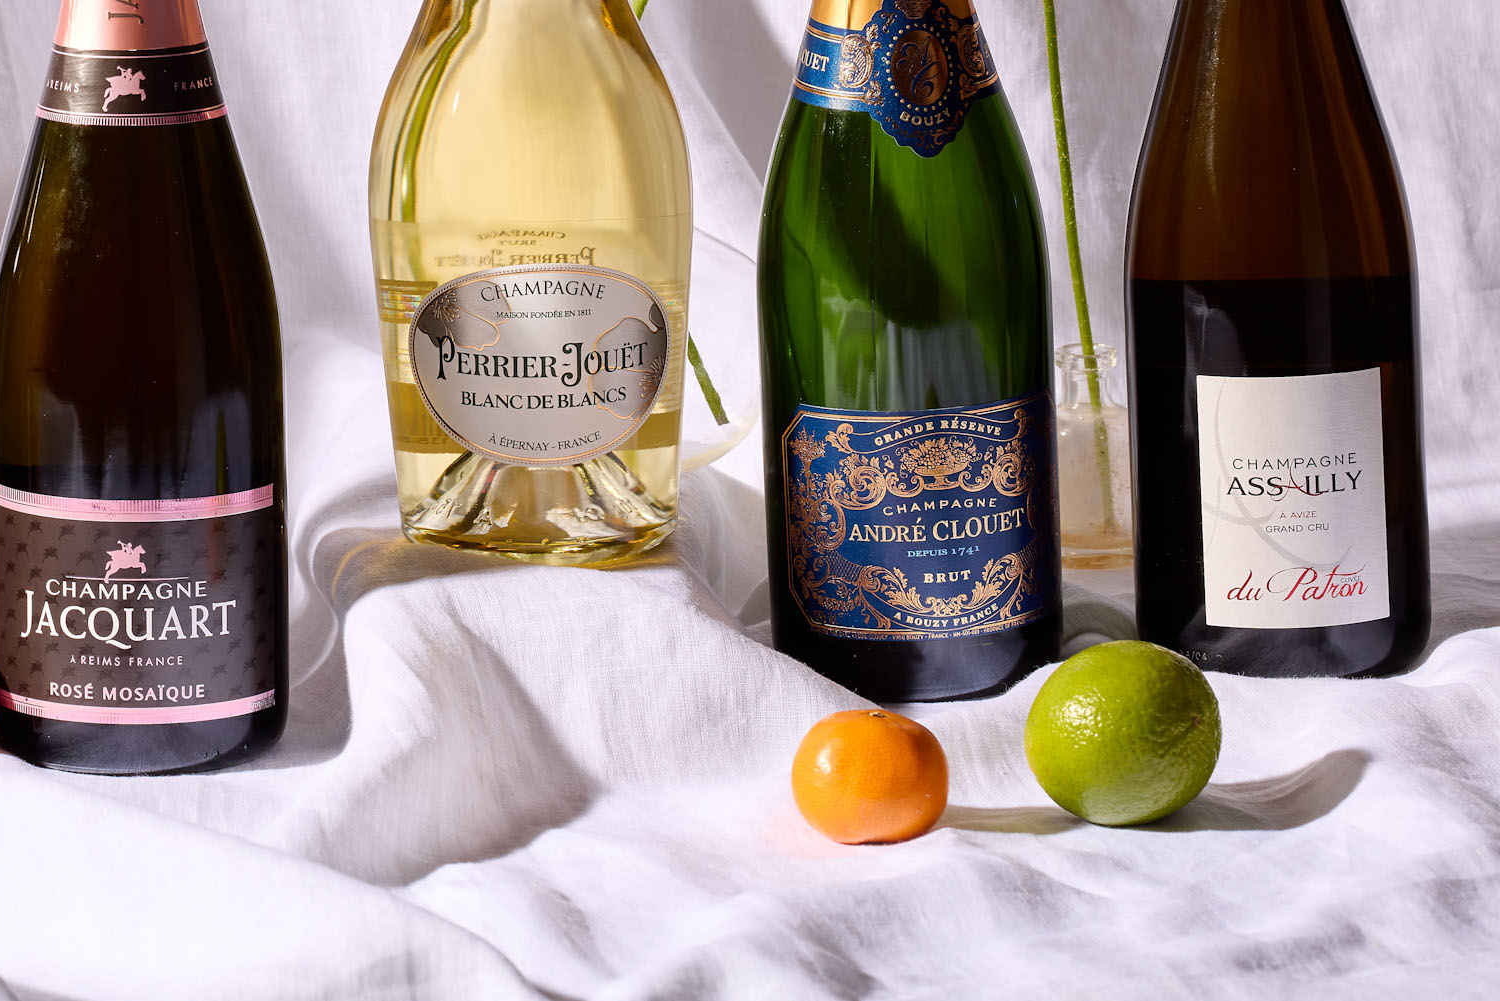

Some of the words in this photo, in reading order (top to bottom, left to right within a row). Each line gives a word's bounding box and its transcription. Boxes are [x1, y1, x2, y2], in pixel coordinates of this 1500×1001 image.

[50, 80, 80, 93] REIMS
[173, 76, 214, 92] FRANCE
[899, 107, 951, 127] BOUZY
[480, 280, 606, 302] CHAMPAGNE
[495, 310, 529, 319] MAISON
[530, 309, 564, 319] FONDÉE
[564, 309, 577, 317] EN
[577, 308, 592, 317] 1811
[436, 335, 649, 387] PERRIER-JOUËT
[461, 390, 523, 410] BLANC
[526, 395, 555, 410] DE
[556, 386, 627, 409] BLANCS
[488, 433, 497, 444] À
[499, 434, 550, 451] ÉPERNAY
[557, 430, 602, 449] FRANCE
[874, 421, 935, 446] GRANDE
[940, 416, 1003, 437] RÉSERVE
[1232, 452, 1357, 470] CHAMPAGNE
[882, 497, 998, 517] CHAMPAGNE
[1290, 510, 1317, 519] AVIZE
[848, 517, 927, 543] ANDRÉ
[932, 507, 1025, 541] CLOUET
[1265, 524, 1304, 533] GRAND
[1307, 523, 1330, 532] CRU
[907, 548, 948, 558] DEPUIS
[950, 545, 980, 556] 1741
[923, 569, 972, 584] BRUT
[1227, 568, 1264, 601] du
[1266, 563, 1369, 602] Patron
[45, 579, 208, 601] CHAMPAGNE
[20, 590, 237, 650] JACQUART
[906, 613, 949, 628] BOUZY
[952, 602, 1000, 627] FRANCE
[69, 654, 76, 664] À
[80, 655, 121, 666] REIMS
[128, 655, 184, 666] FRANCE
[49, 682, 94, 700] ROSÉ
[102, 683, 206, 703] MOSAÏQUE
